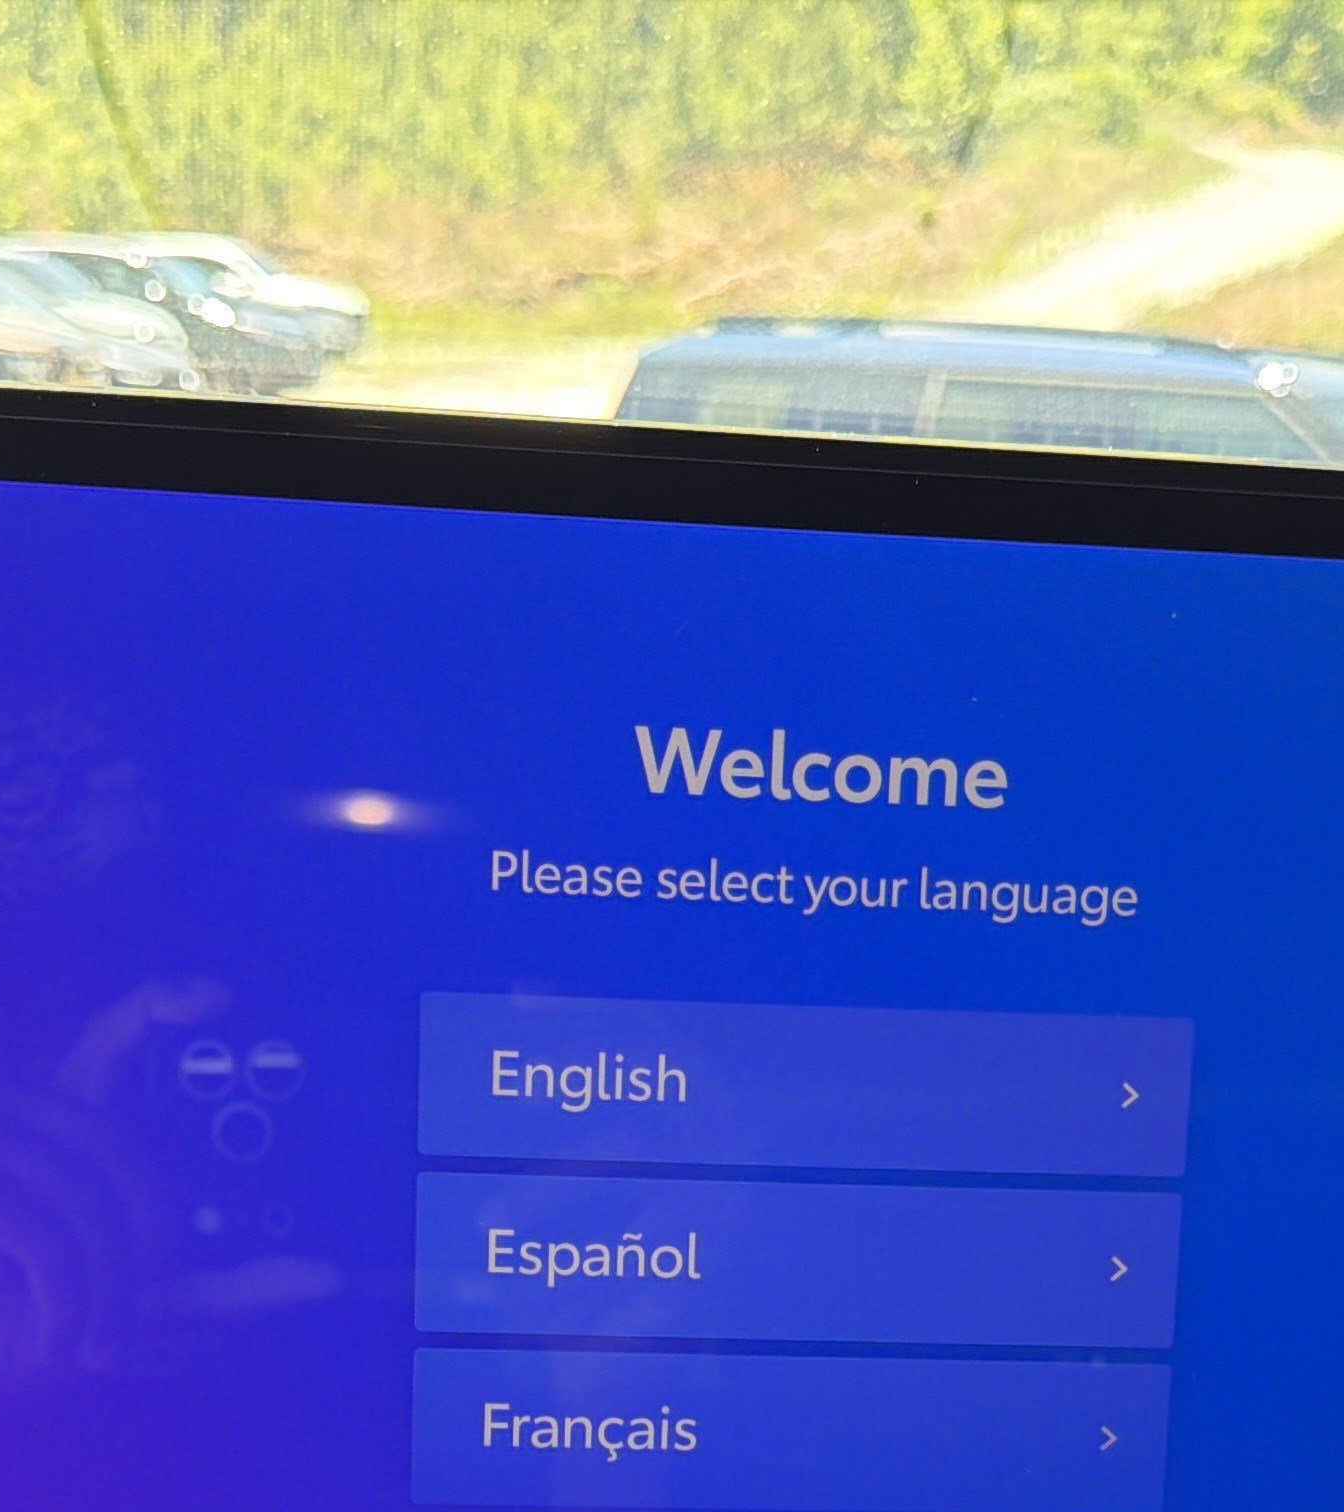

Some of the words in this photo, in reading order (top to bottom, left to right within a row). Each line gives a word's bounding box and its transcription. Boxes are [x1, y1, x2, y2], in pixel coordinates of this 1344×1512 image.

[635, 724, 1009, 810] Welcome
[490, 849, 643, 898] Please
[657, 858, 794, 906] select
[803, 871, 907, 915] your
[920, 867, 1139, 927] language
[490, 1050, 688, 1112] English
[487, 1228, 701, 1288] Español
[481, 1402, 698, 1462] Français
